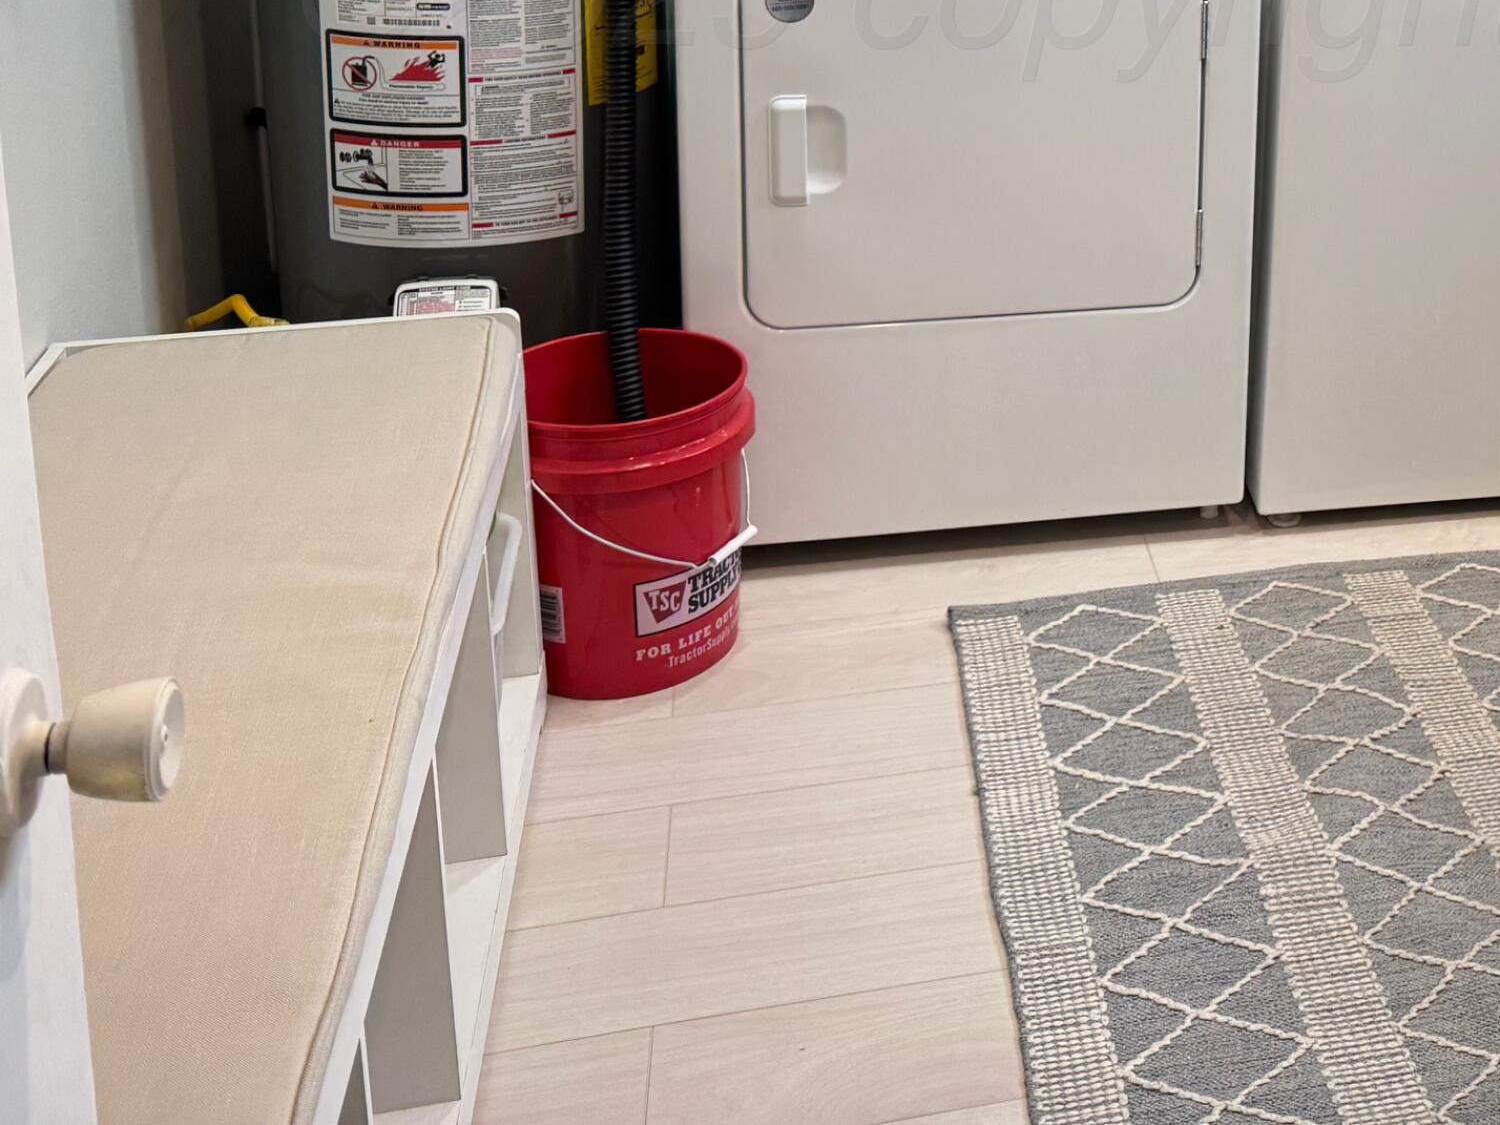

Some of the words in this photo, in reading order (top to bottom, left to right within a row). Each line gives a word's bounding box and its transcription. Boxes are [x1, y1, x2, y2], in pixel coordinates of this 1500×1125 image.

[373, 40, 421, 49] WARNING
[380, 140, 420, 148] DANGER
[382, 204, 424, 212] WARNING
[649, 590, 681, 612] TSC
[635, 644, 672, 662] FOR
[678, 626, 712, 650] LIFE
